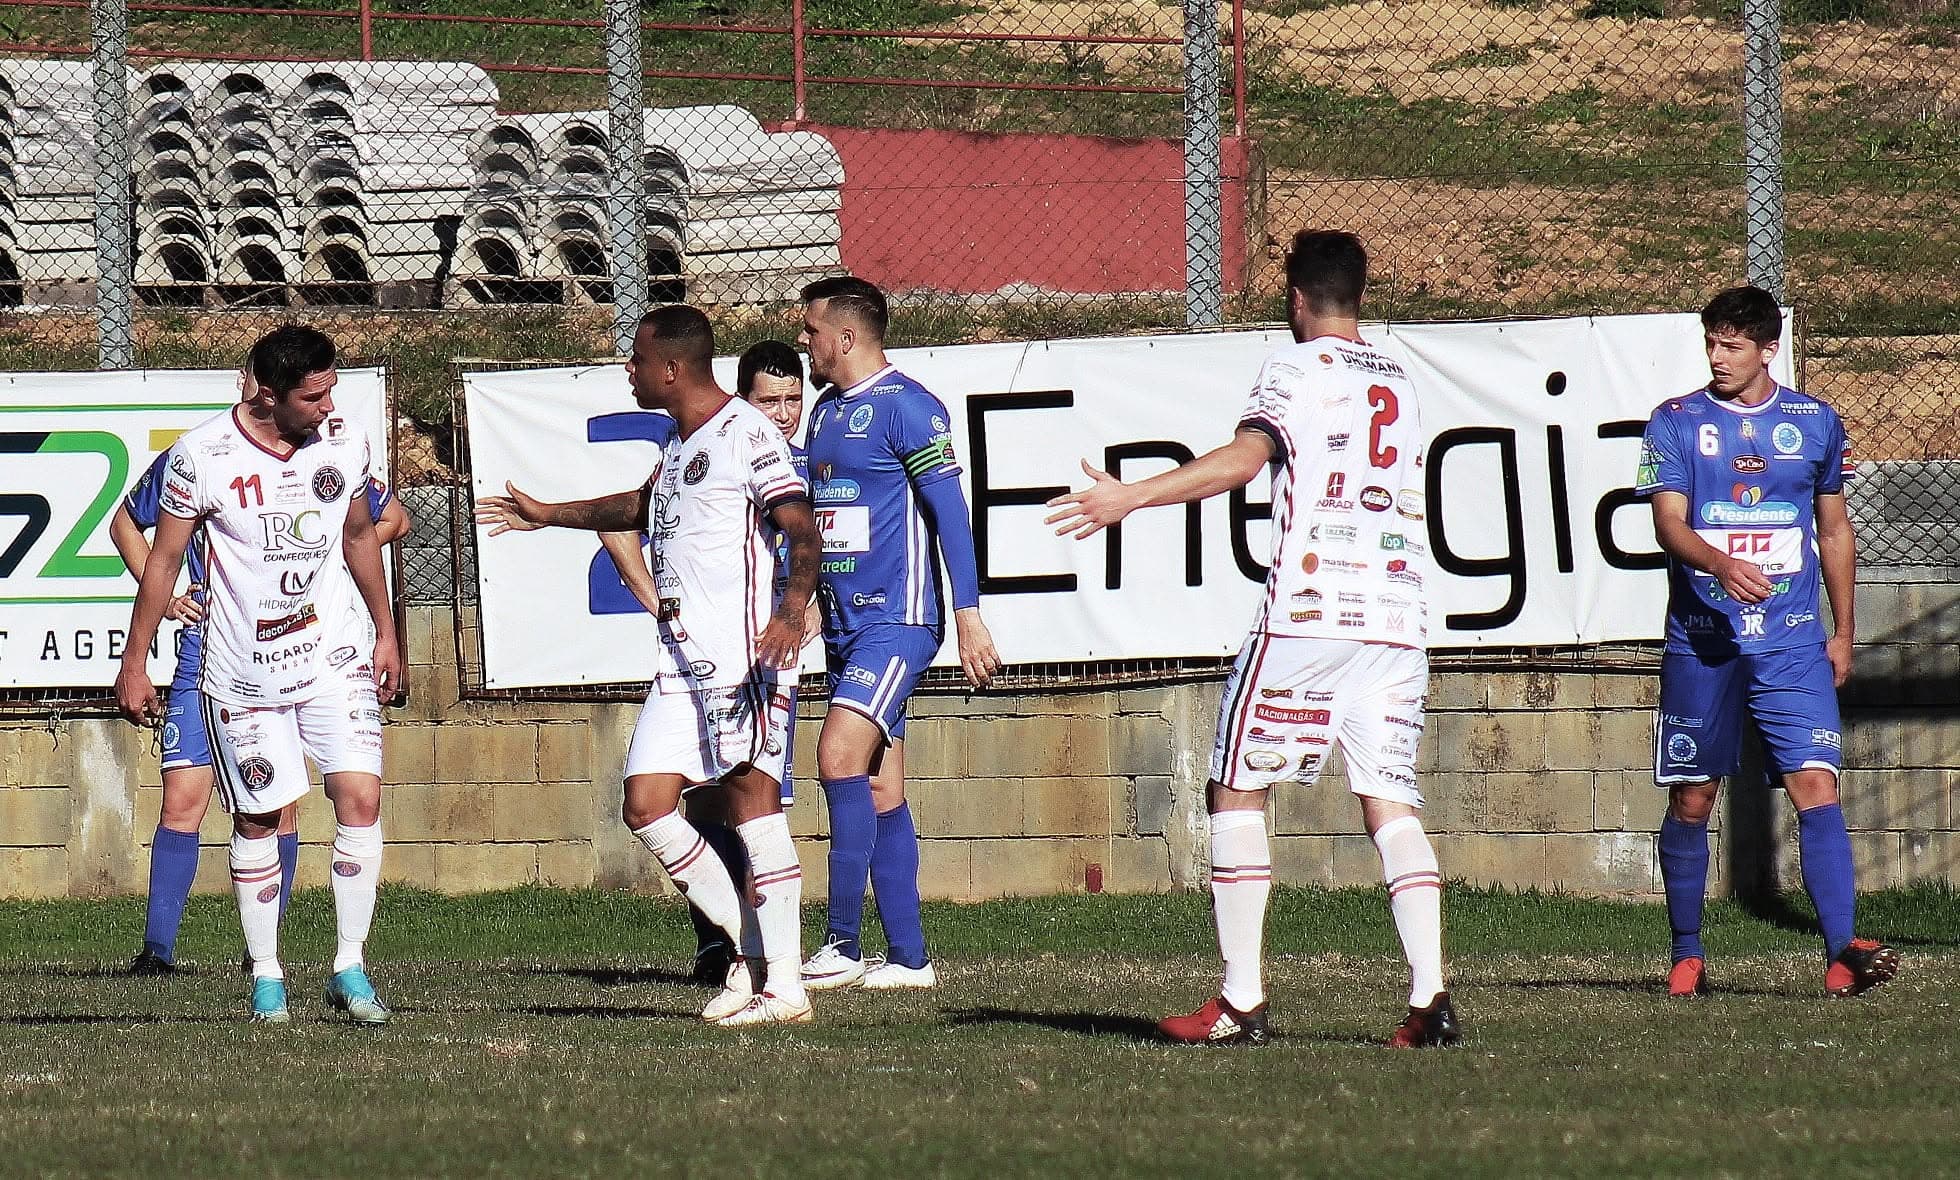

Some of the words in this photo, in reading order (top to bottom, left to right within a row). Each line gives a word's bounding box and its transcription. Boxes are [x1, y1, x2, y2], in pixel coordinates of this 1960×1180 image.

[1367, 384, 1399, 470] 2
[1699, 423, 1720, 456] 6
[228, 474, 264, 509] 11
[967, 372, 1664, 630] Enegia
[1709, 503, 1794, 522] Presidente
[822, 536, 849, 549] bricar
[820, 557, 856, 574] credi
[1208, 1024, 1242, 1041] adidas
